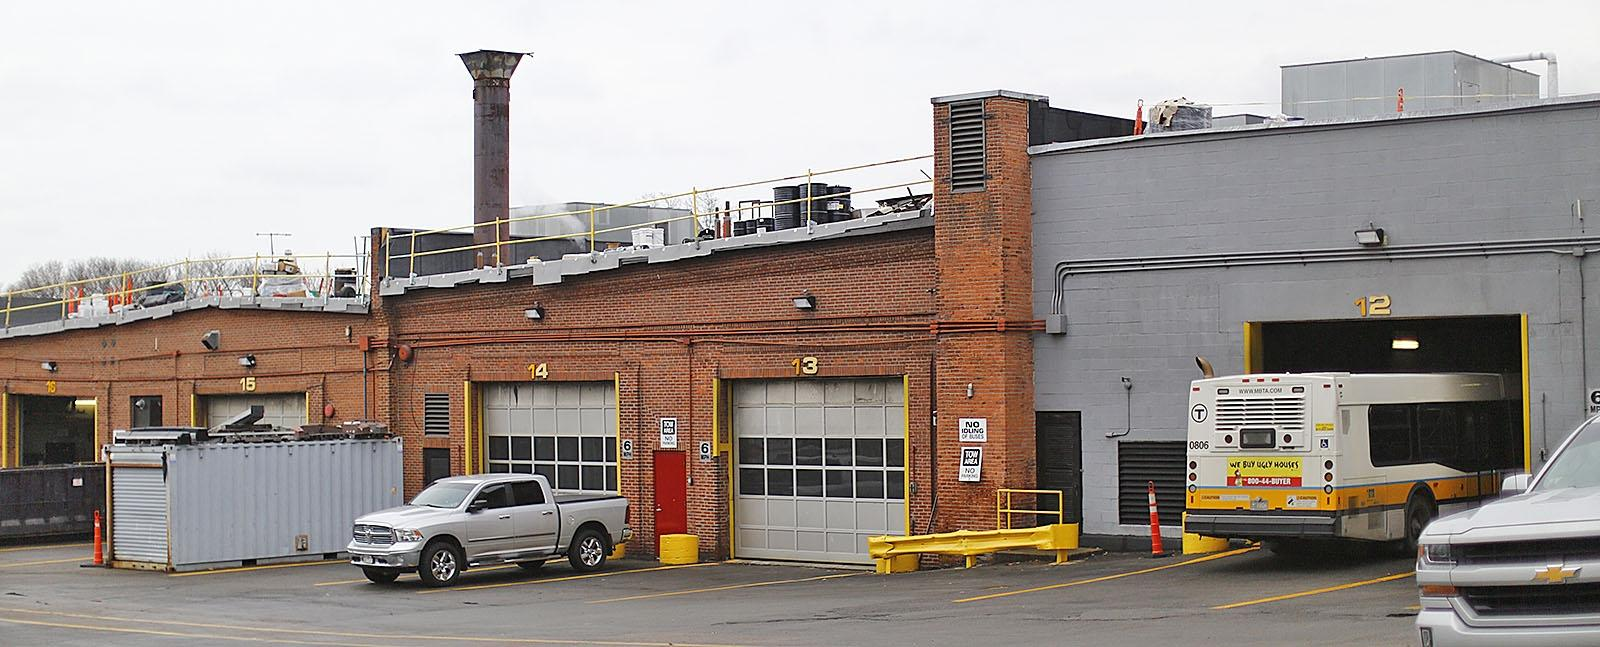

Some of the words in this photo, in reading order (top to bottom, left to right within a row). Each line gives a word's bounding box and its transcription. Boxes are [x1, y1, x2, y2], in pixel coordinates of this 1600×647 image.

[1354, 295, 1391, 317] 12
[527, 362, 549, 380] 14
[791, 356, 818, 376] 13
[45, 380, 56, 394] 16
[240, 376, 256, 392] 15
[1591, 390, 1600, 404] 6
[623, 440, 632, 451] 6
[701, 443, 709, 454] 6
[1189, 440, 1209, 450] 0806
[965, 450, 979, 458] TOW
[1242, 460, 1256, 469] BUY
[1256, 461, 1273, 469] UGLY
[1274, 461, 1299, 469] HOUSES
